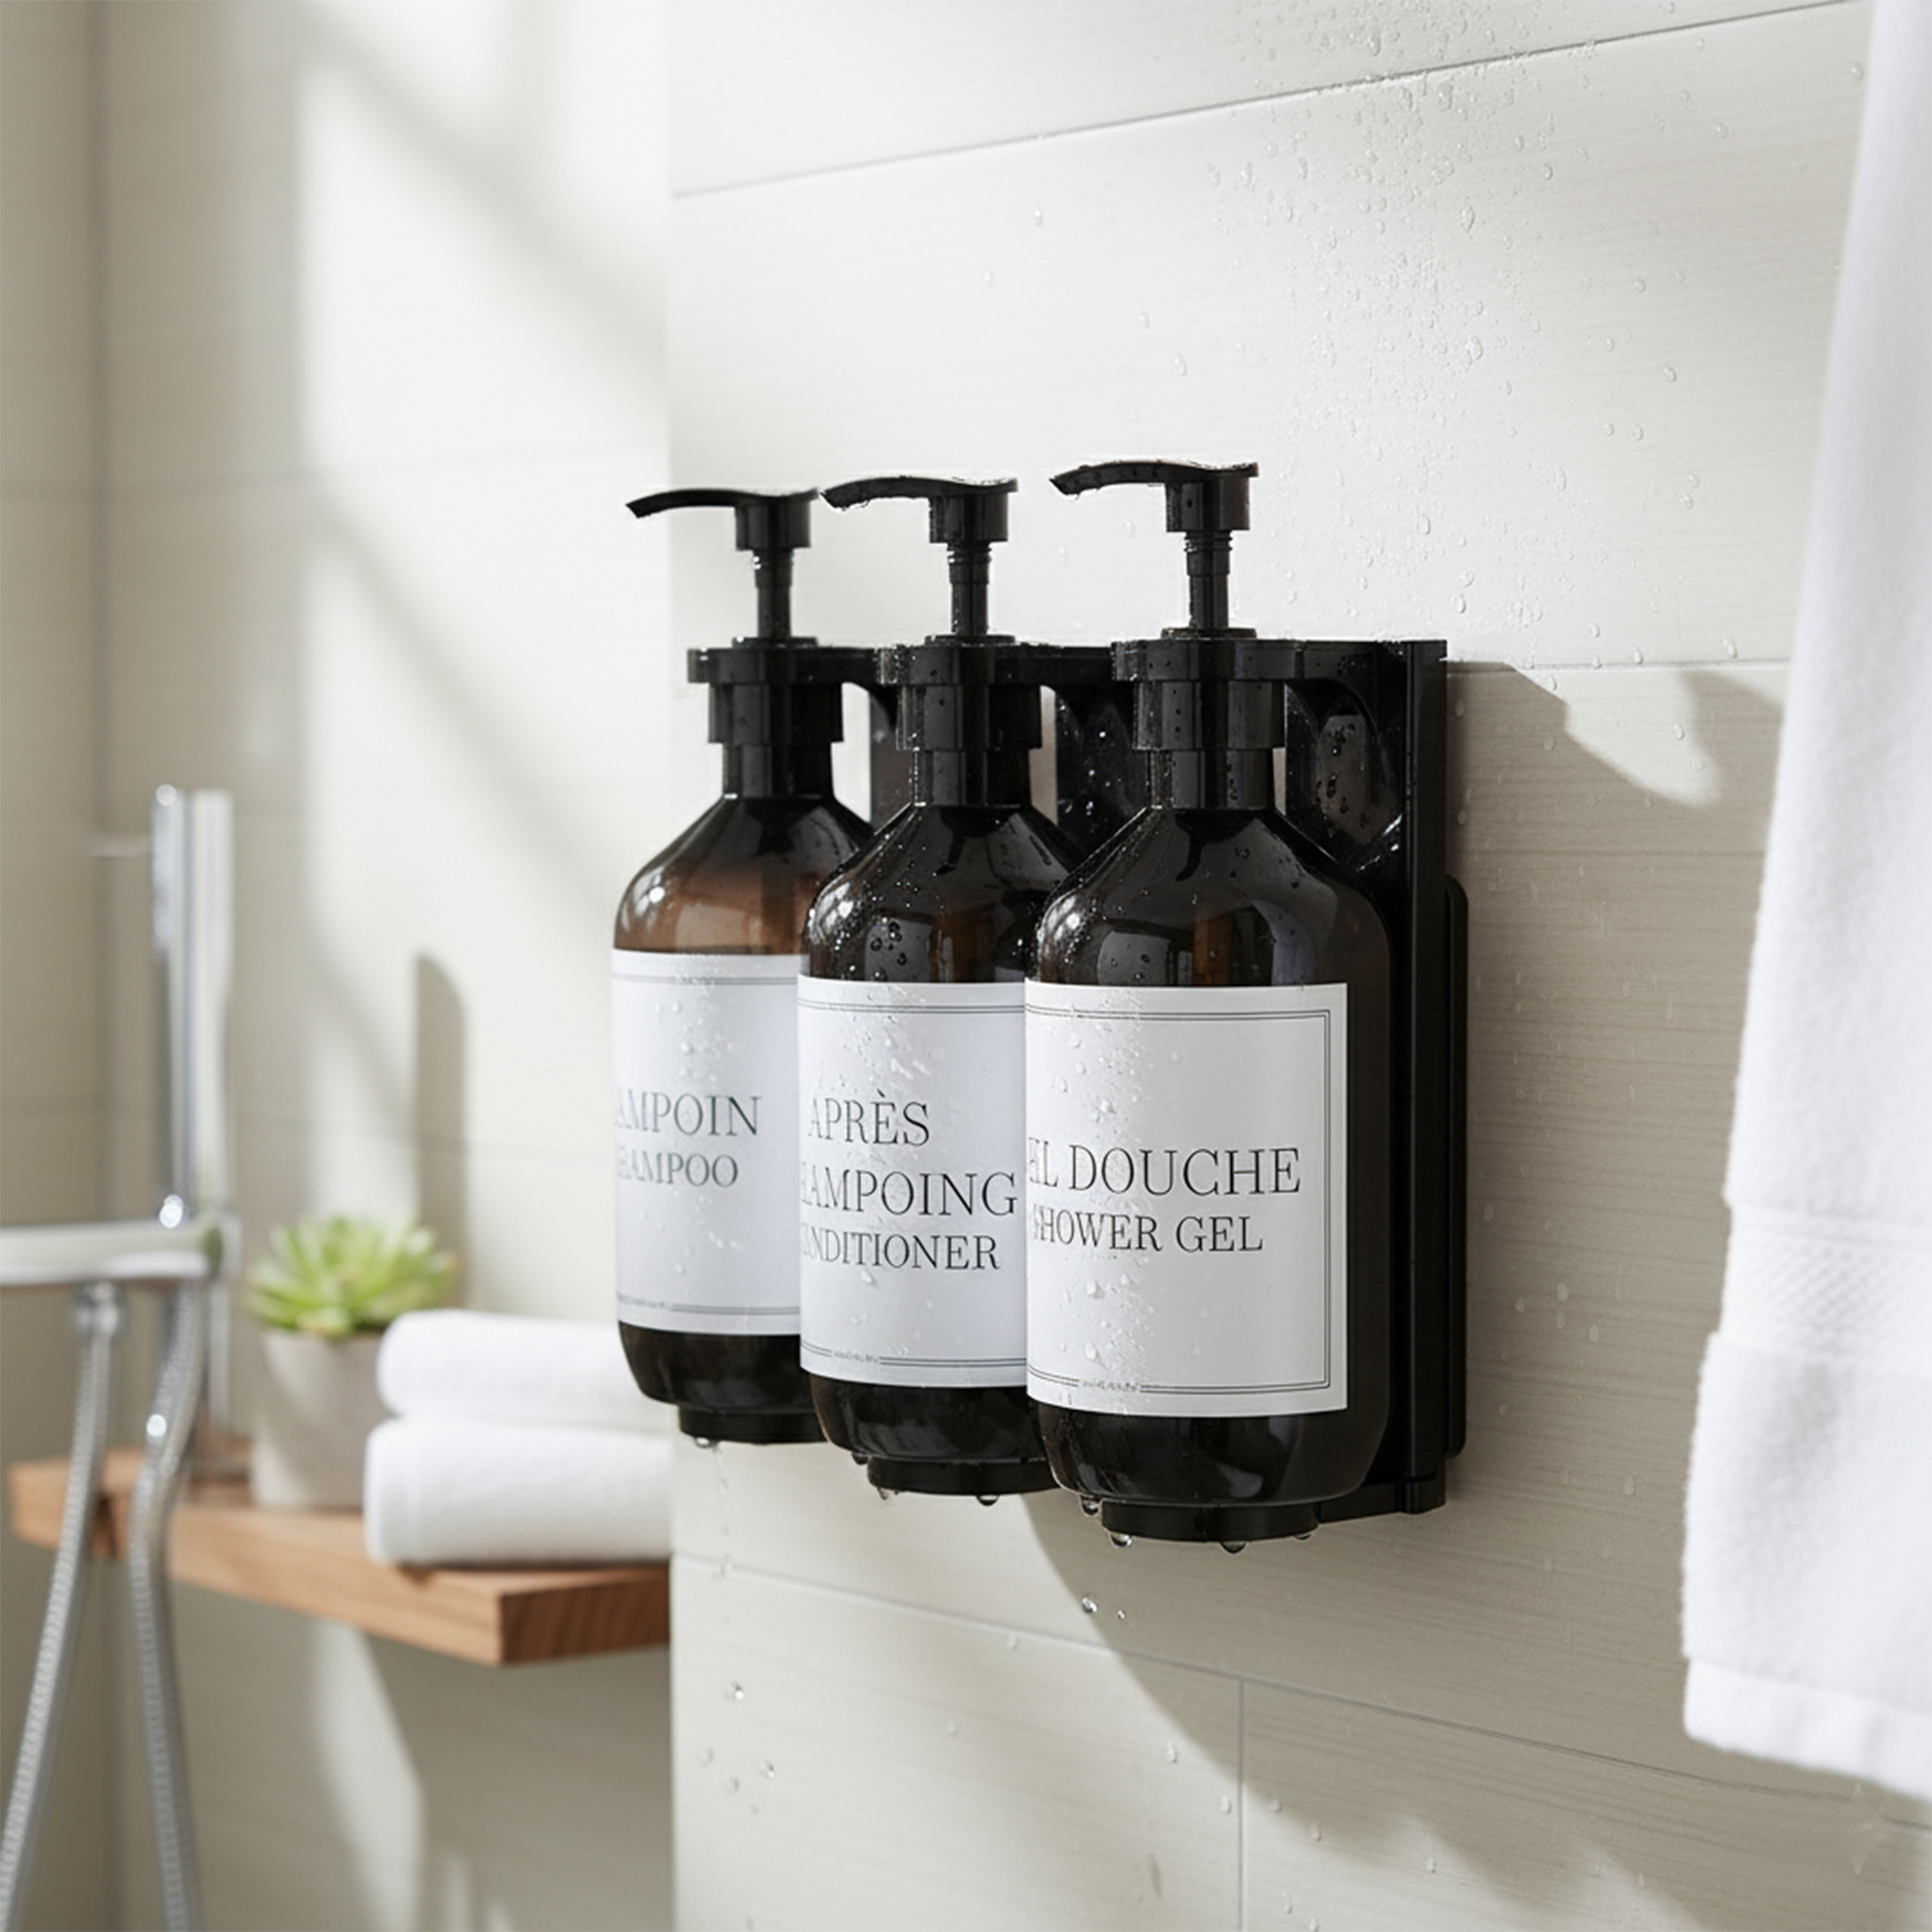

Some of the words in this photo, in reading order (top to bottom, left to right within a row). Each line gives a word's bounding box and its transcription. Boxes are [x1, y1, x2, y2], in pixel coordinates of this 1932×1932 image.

[809, 1089, 930, 1147] APRÈS
[1068, 1144, 1301, 1196] DOUCHE
[1176, 1215, 1264, 1252] GEL
